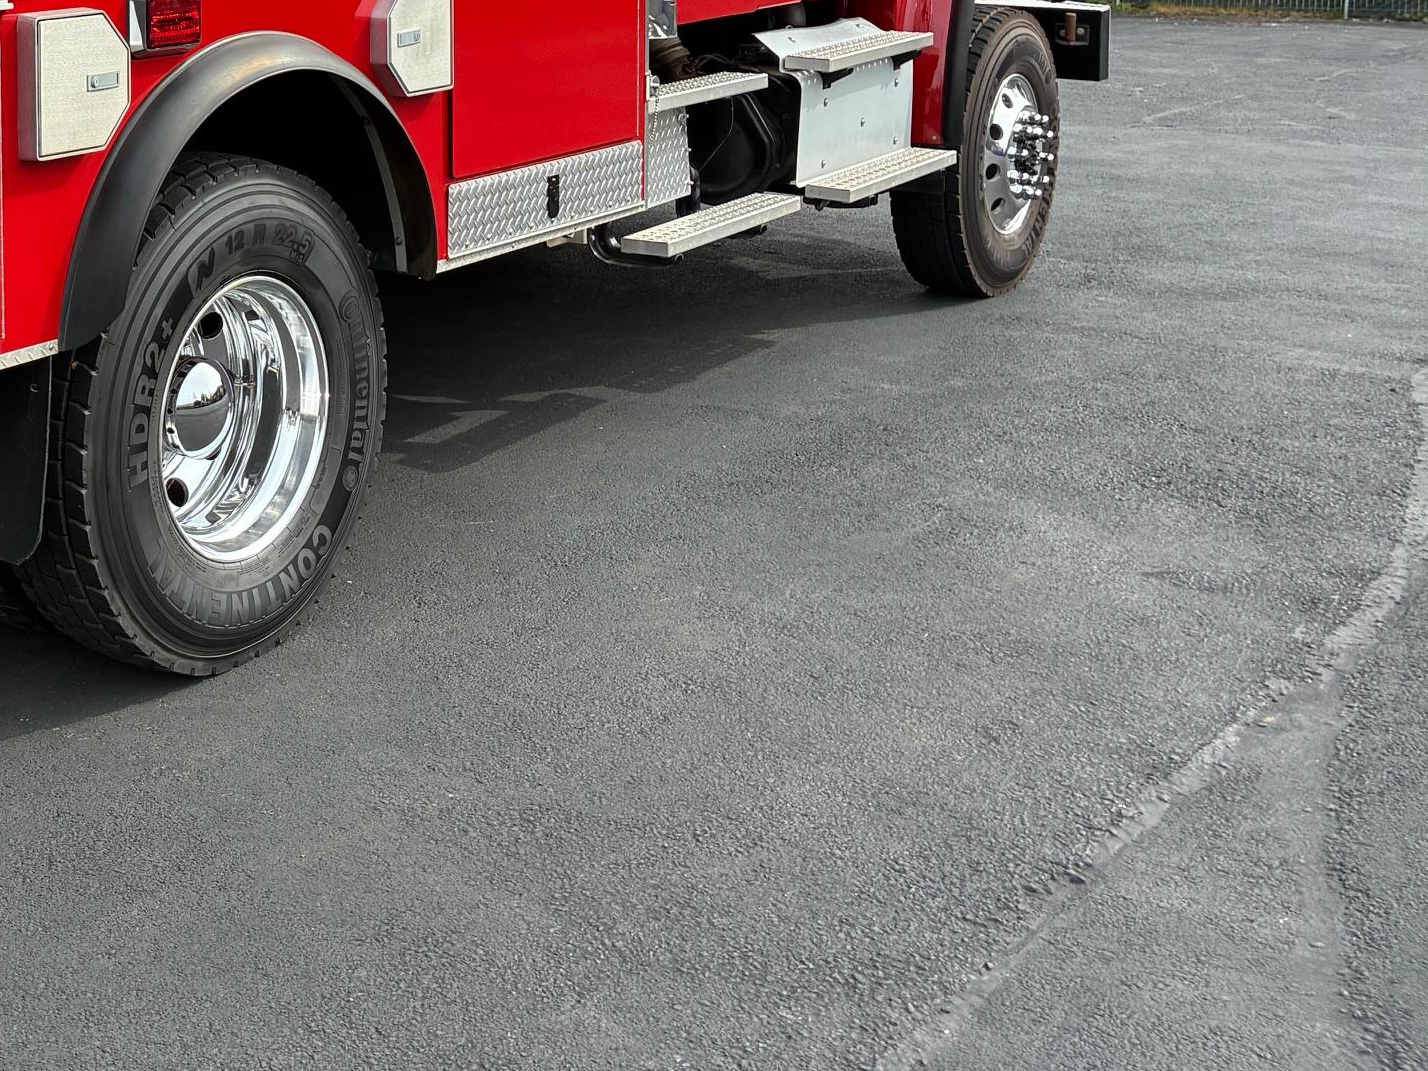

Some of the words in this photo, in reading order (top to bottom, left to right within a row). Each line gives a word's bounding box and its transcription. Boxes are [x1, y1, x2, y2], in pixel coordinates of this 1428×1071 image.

[225, 229, 245, 255] 12
[128, 318, 174, 492] HDR2+
[148, 525, 332, 627] CONTINENTAL
